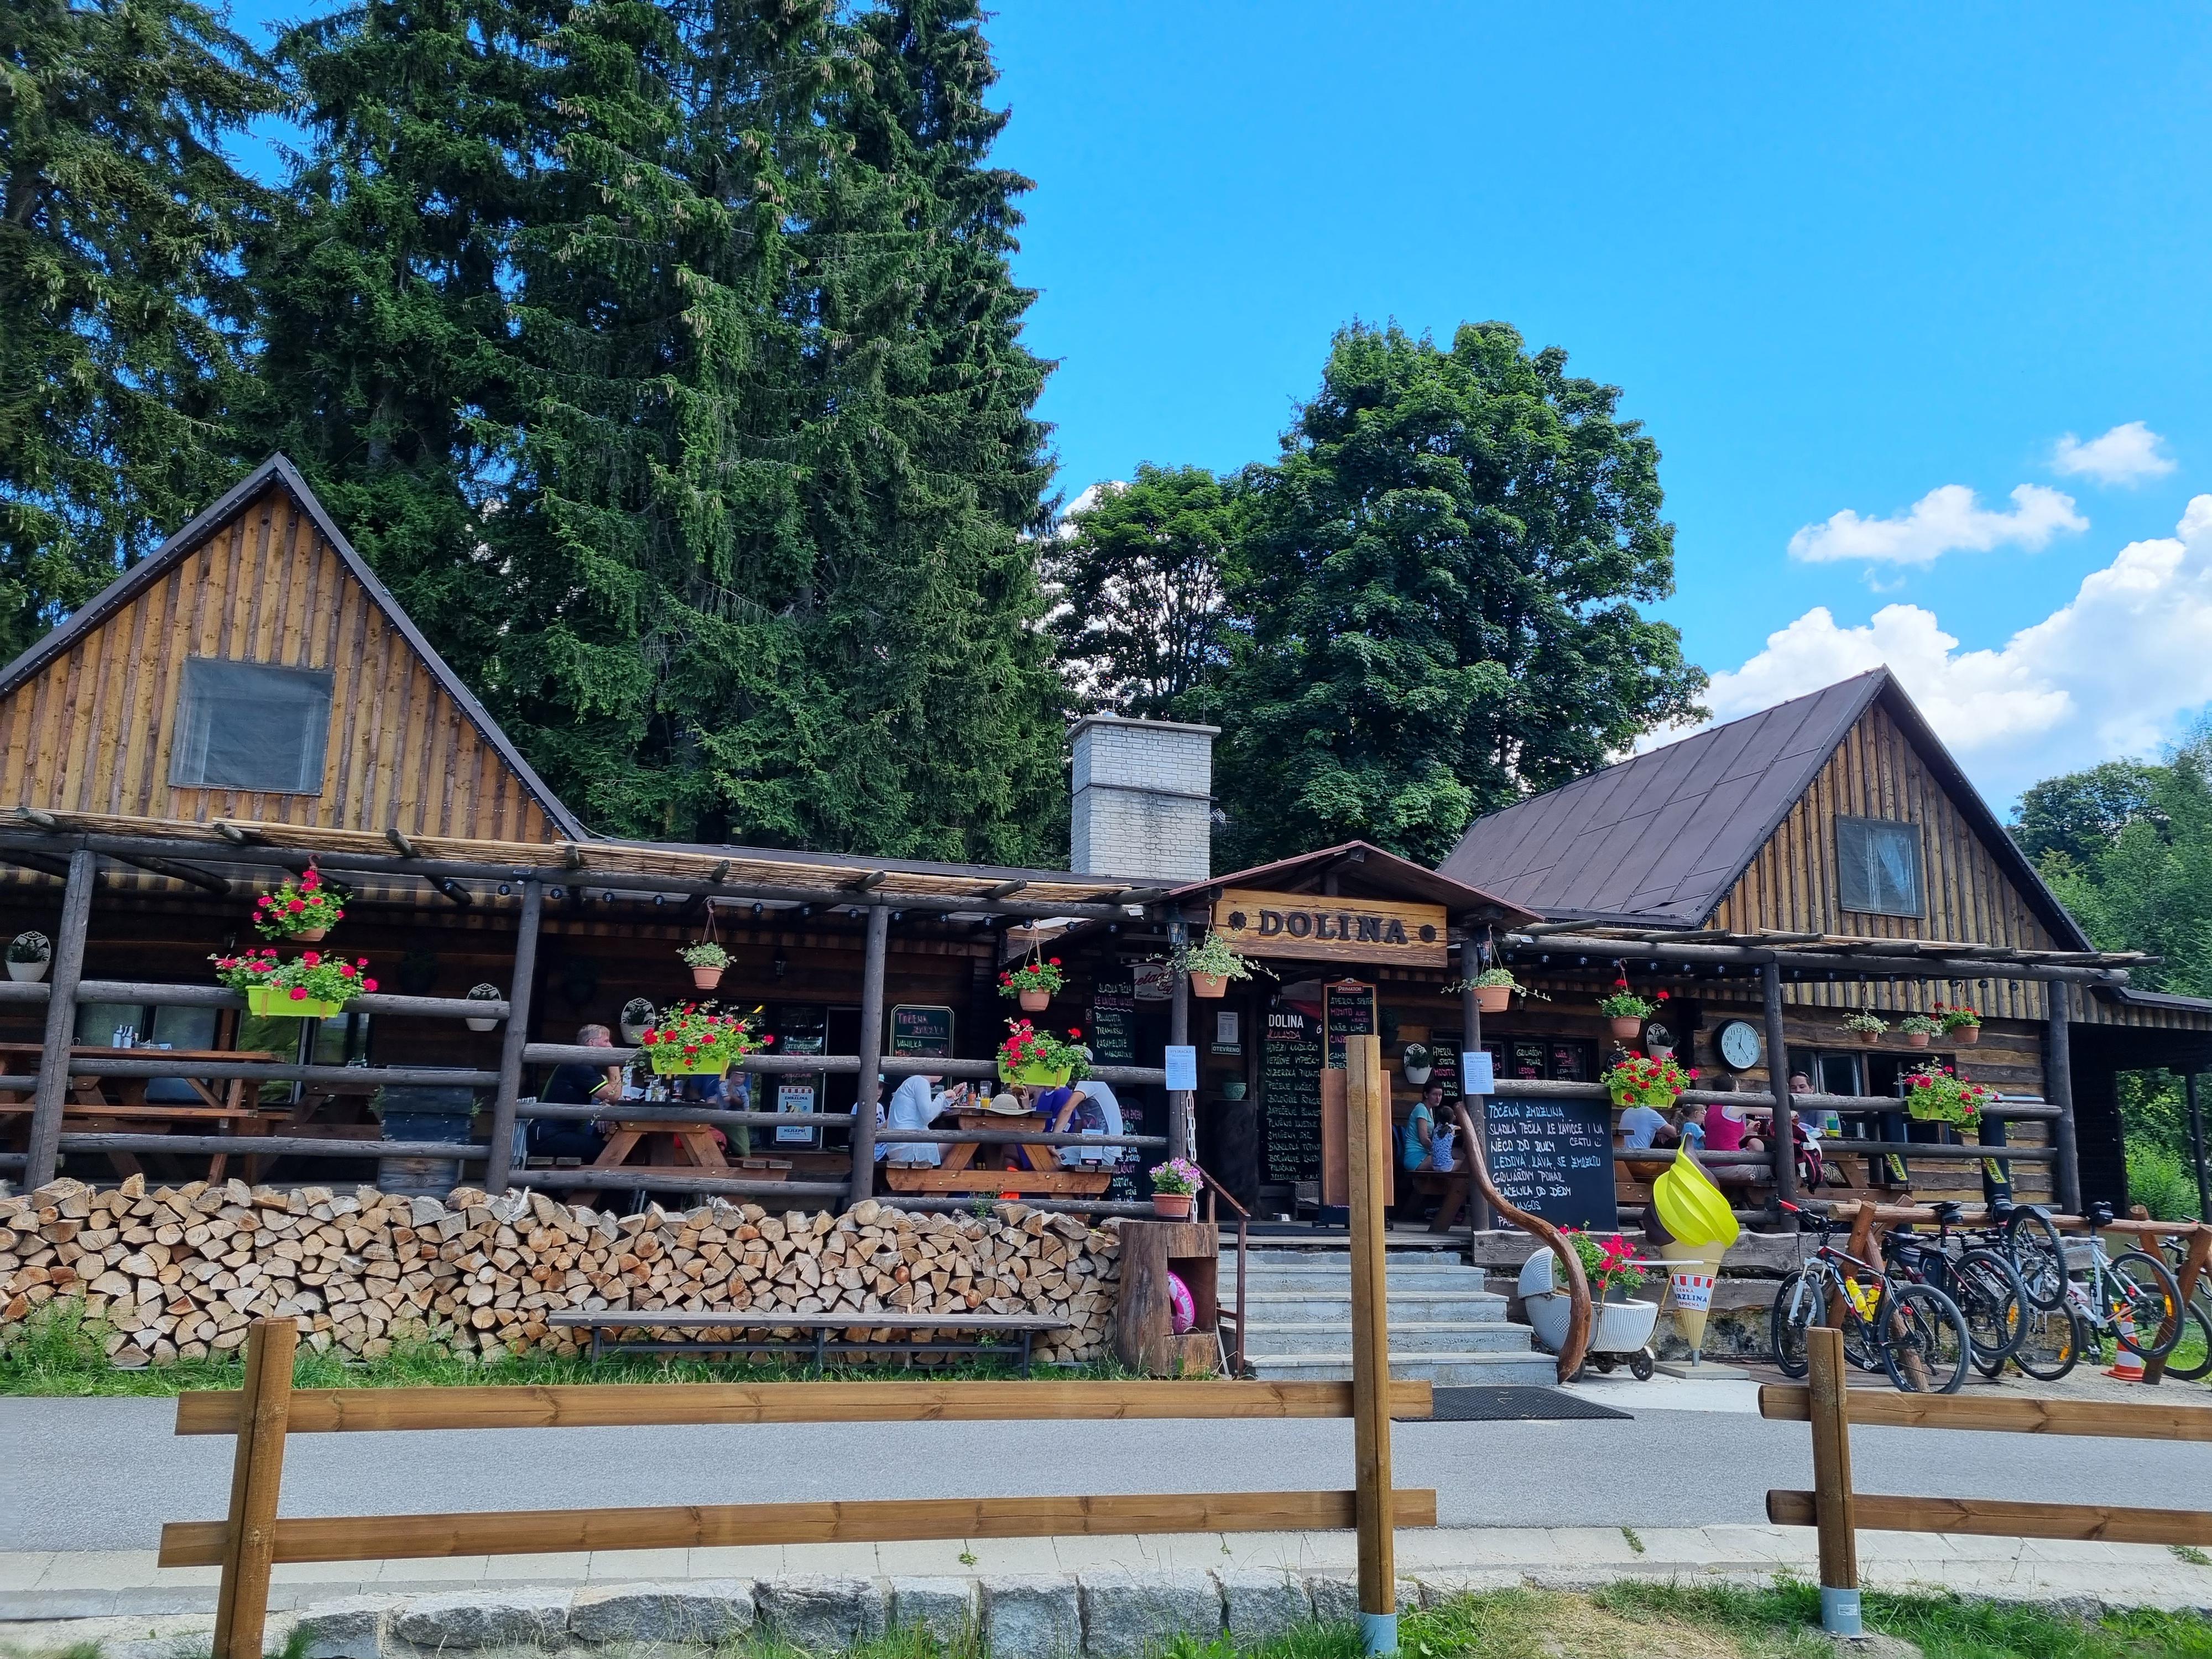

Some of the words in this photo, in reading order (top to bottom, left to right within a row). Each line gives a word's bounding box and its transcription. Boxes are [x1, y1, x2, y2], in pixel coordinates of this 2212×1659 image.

[1259, 909, 1408, 944] DOLINA
[1330, 1008, 1353, 1016] MOJITO
[1269, 1014, 1304, 1028] DOLINA
[1330, 1023, 1347, 1031] NAŠE
[896, 1039, 923, 1048] VANILKA
[1433, 1046, 1454, 1057] APEROL
[1434, 1068, 1455, 1077] MOJITO
[1489, 1102, 1520, 1119] TOČENÁ
[1526, 1105, 1564, 1118] ZMRZLINA
[1489, 1120, 1517, 1135] SLADKÁ
[1519, 1120, 1542, 1135] TEČKA
[1547, 1121, 1556, 1134] KE
[1588, 1123, 1590, 1134] I
[1593, 1123, 1604, 1134] NA
[1490, 1138, 1514, 1154] NĚCO
[1517, 1139, 1530, 1152] DO
[1535, 1141, 1556, 1152] RUKY
[1569, 1137, 1592, 1147] CESTU
[1493, 1152, 1527, 1170] LEDOVÁ
[1557, 1156, 1567, 1167] SE
[1537, 1167, 1565, 1183] POHÁR
[1535, 1186, 1546, 1197] OD
[1550, 1184, 1572, 1197] DĚDY
